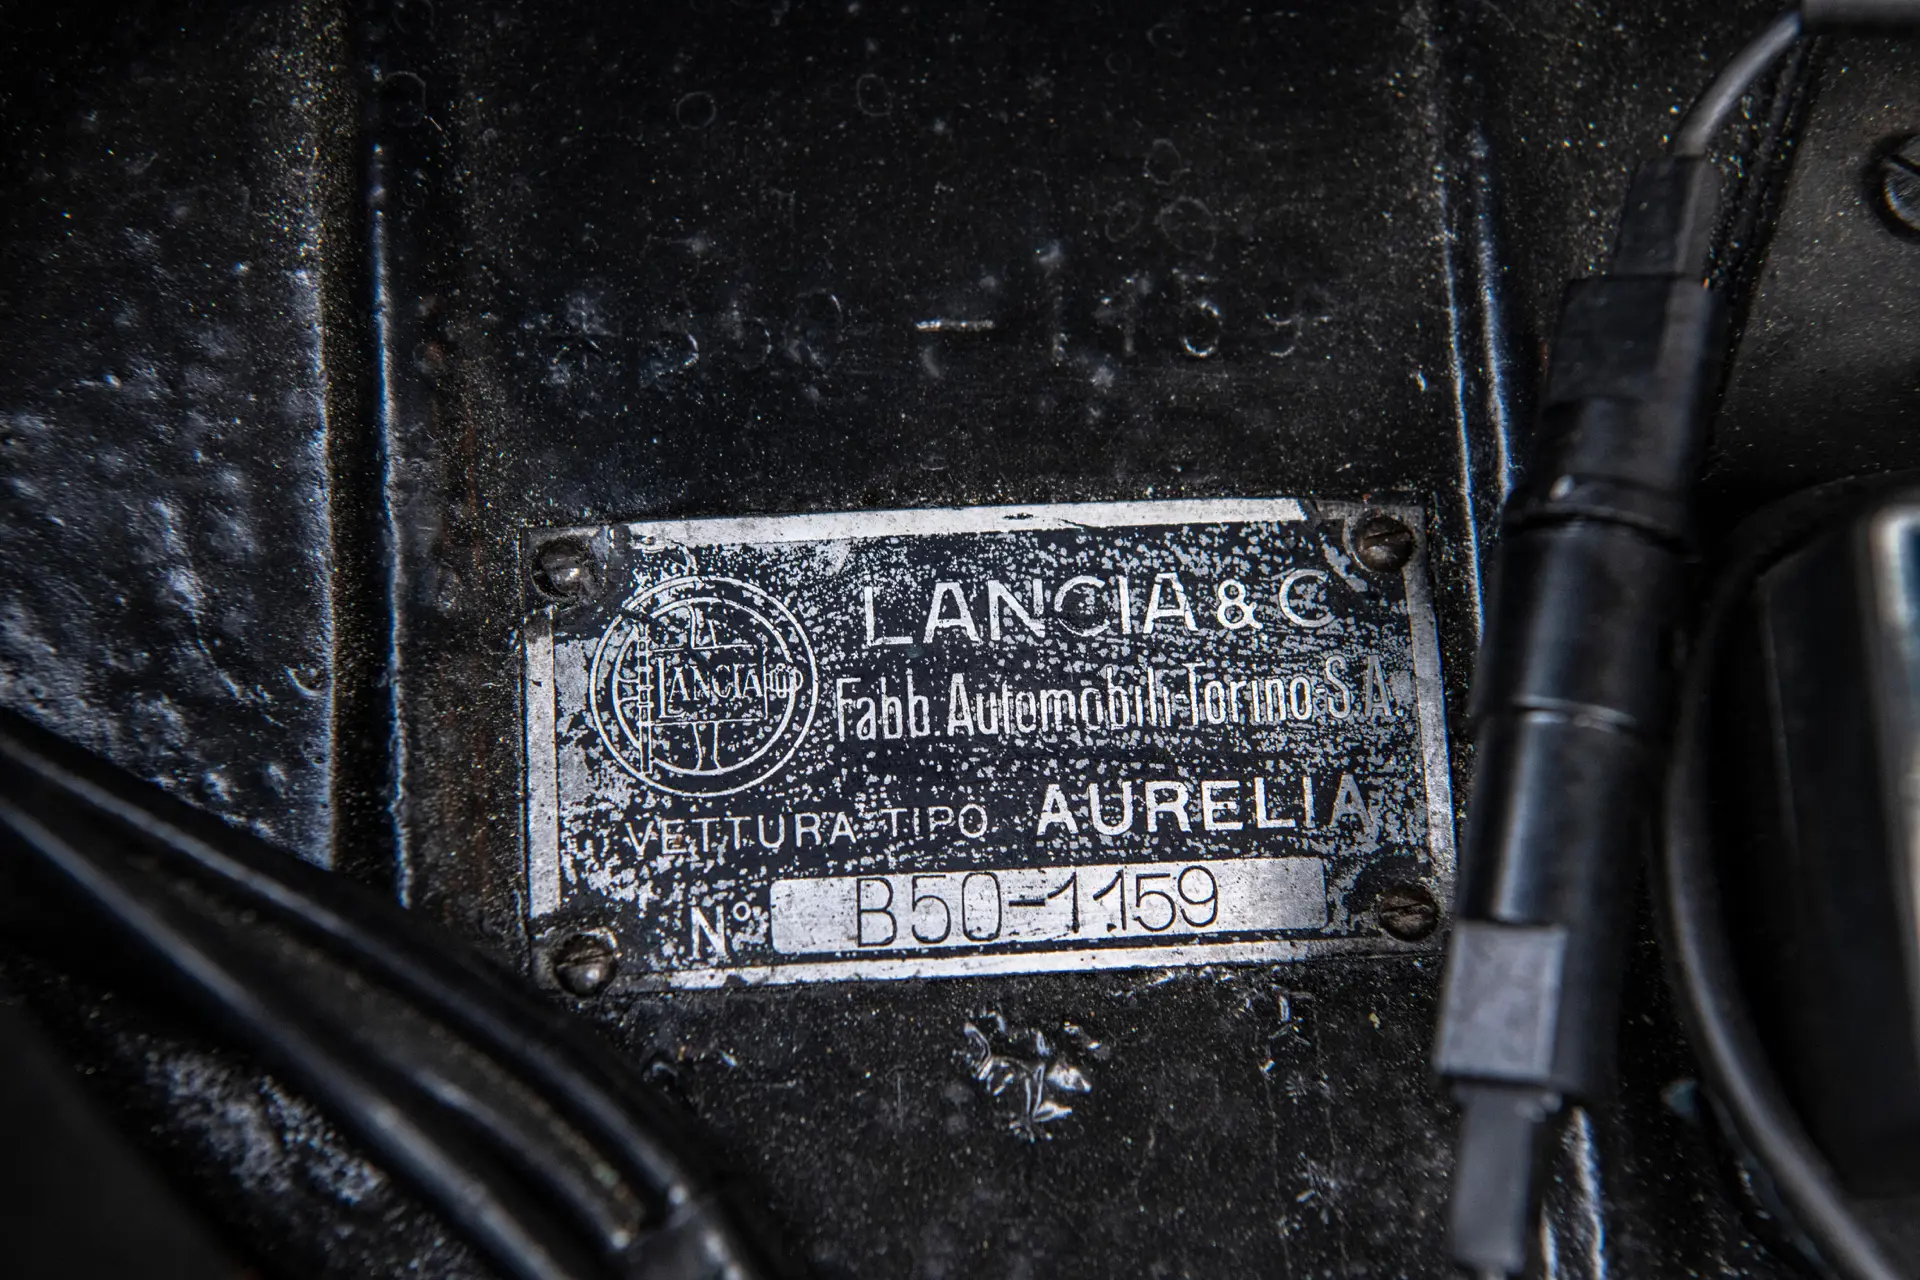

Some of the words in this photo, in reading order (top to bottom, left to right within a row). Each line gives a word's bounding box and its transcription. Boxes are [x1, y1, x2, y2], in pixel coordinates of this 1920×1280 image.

[862, 570, 1199, 648] LANCIA
[1216, 577, 1264, 630] &
[656, 655, 765, 718] LANCIA
[624, 810, 858, 857] VETTURA
[884, 802, 990, 840] TIPO
[1036, 772, 1376, 836] AURELIA
[856, 864, 1219, 949] B50-1159
